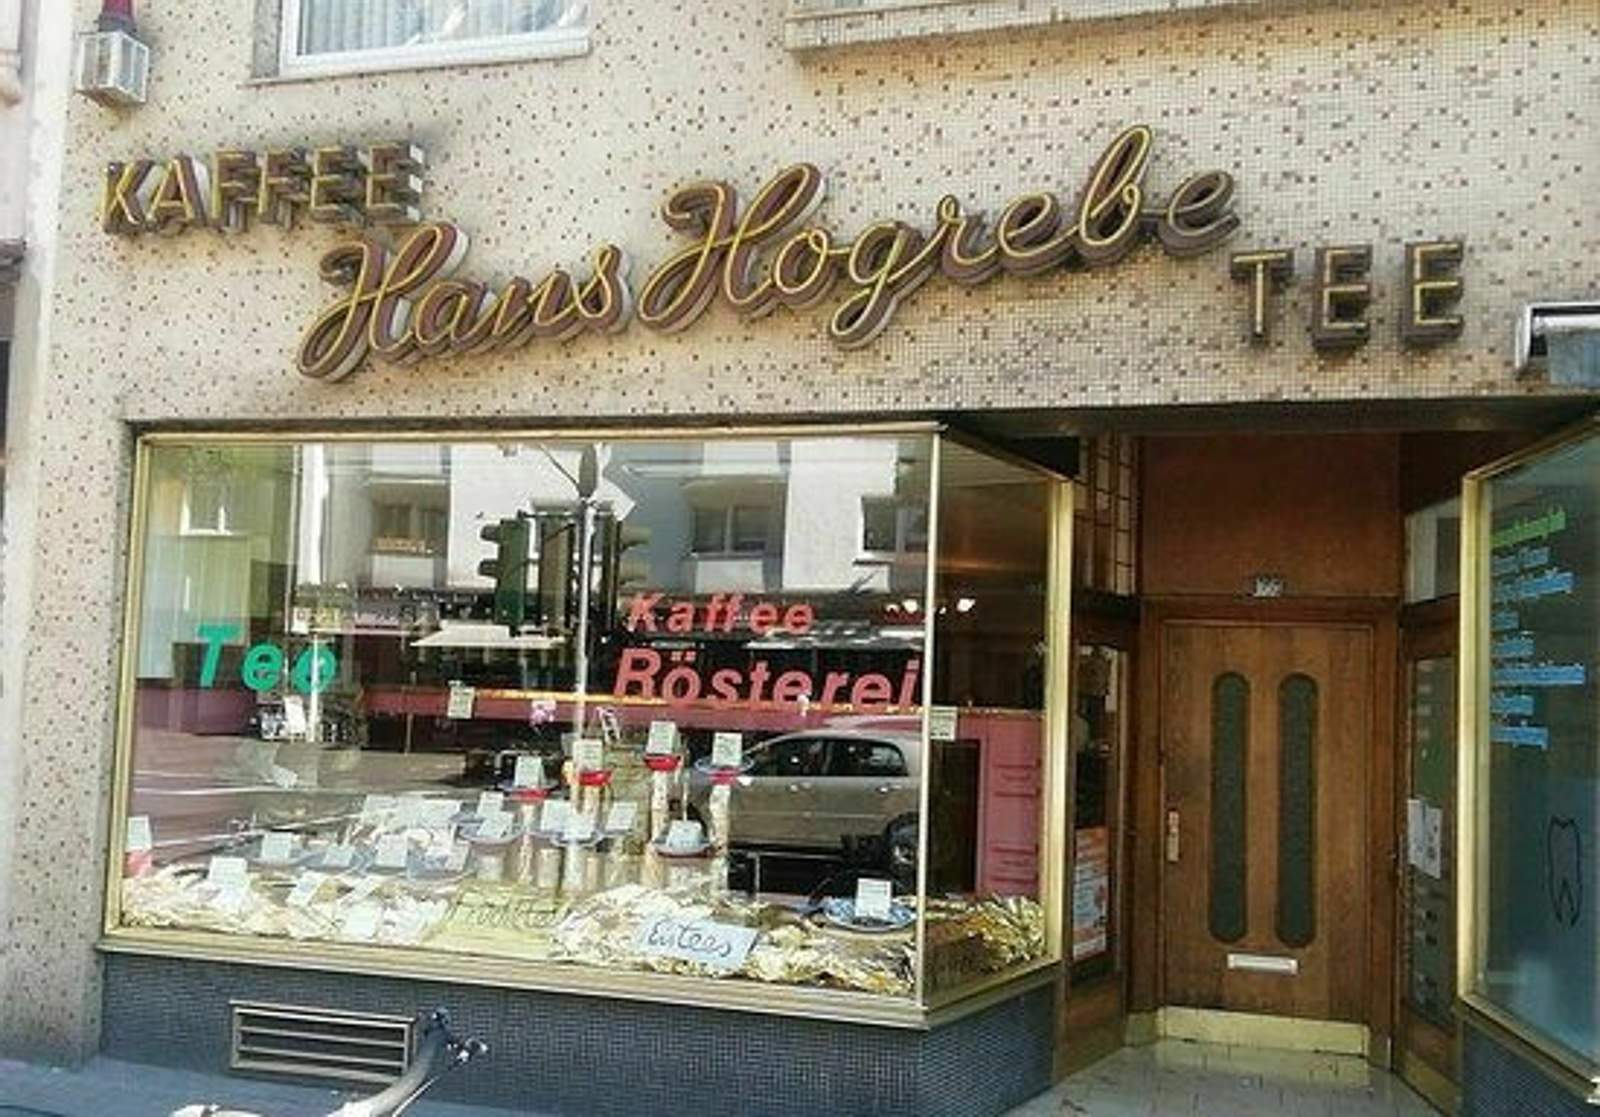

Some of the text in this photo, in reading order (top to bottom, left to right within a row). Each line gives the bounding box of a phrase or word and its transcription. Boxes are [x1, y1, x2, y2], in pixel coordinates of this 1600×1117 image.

[103, 143, 426, 235] KAFFEE
[297, 125, 1241, 382] Hans Hogrebe
[1230, 241, 1466, 351] TEE
[625, 591, 815, 635] Kaffee
[195, 624, 338, 693] Tee
[612, 647, 921, 710] Rösterei
